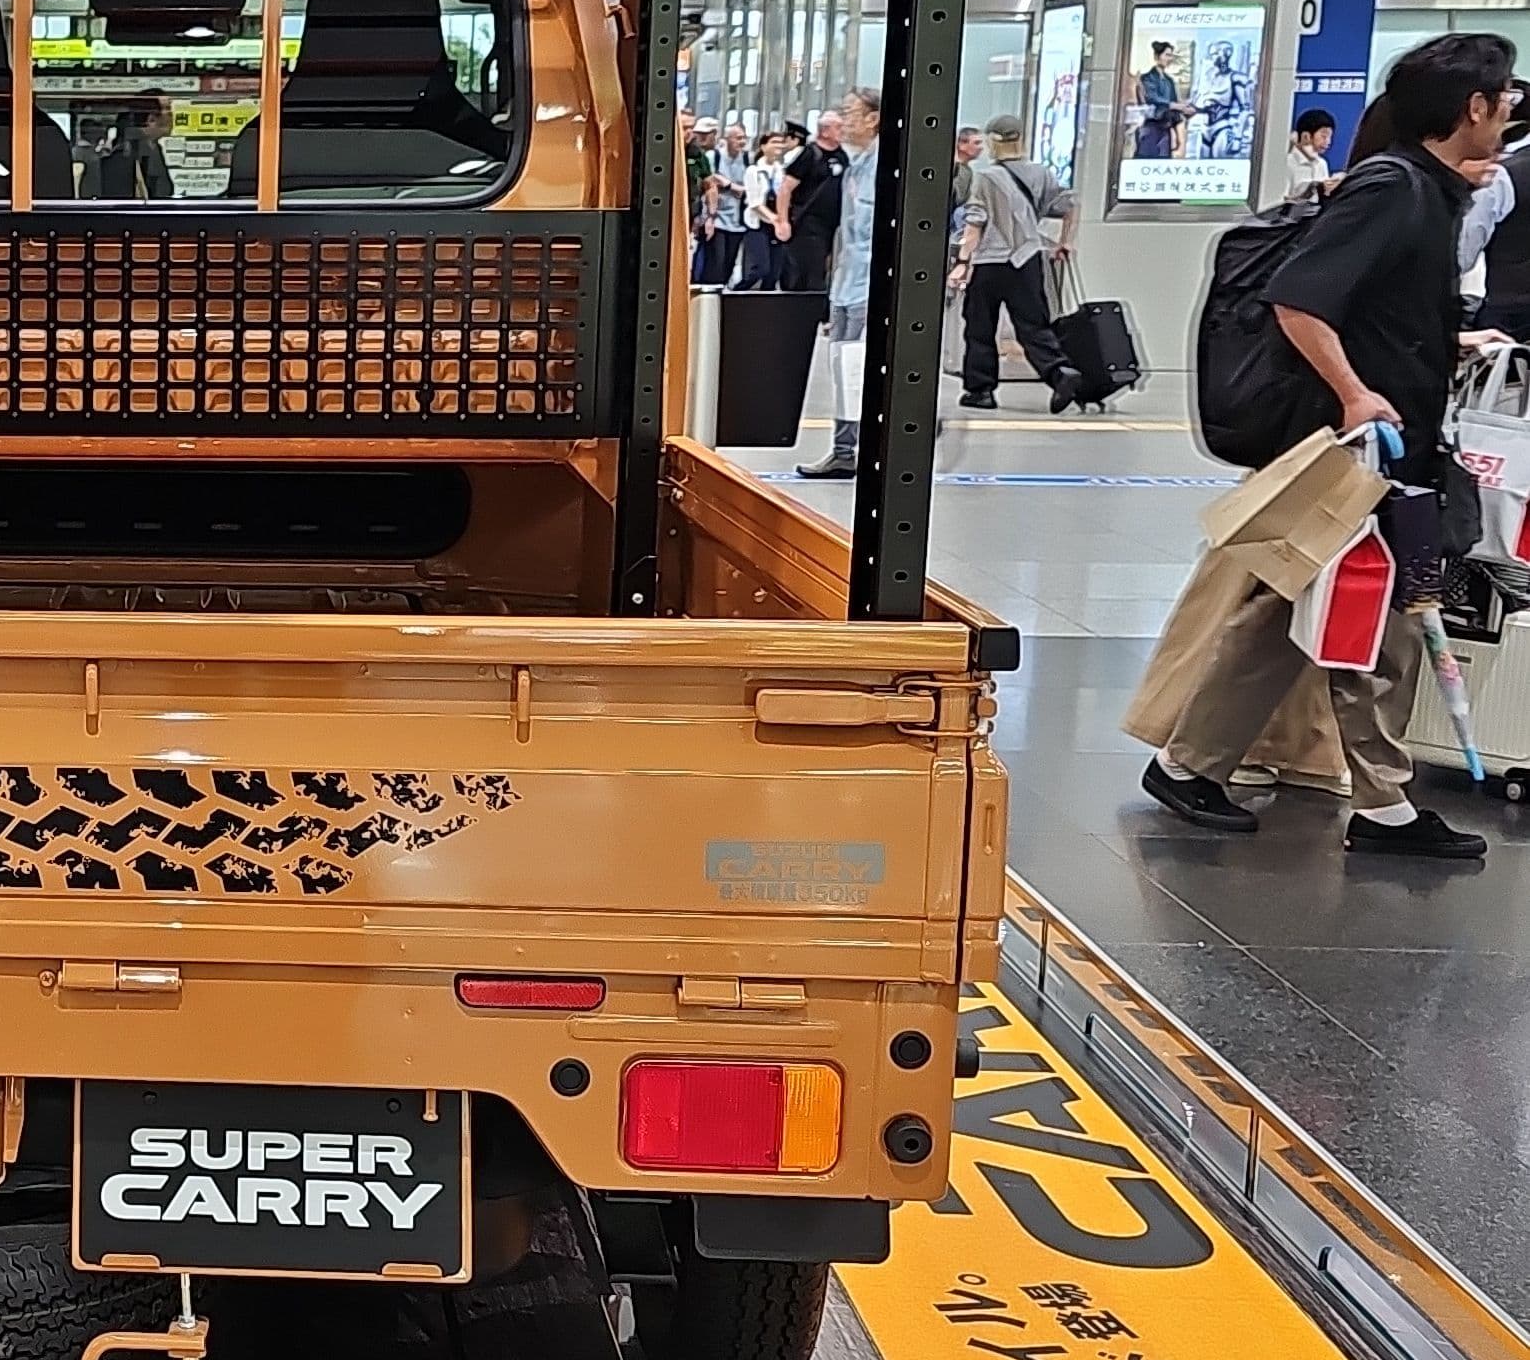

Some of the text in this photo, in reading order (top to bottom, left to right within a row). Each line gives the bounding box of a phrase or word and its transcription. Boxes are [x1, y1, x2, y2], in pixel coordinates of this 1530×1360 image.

[1148, 12, 1172, 24] OLD
[1174, 12, 1214, 24] MEETS
[1140, 166, 1230, 176] OKAYA & Co.
[1461, 451, 1505, 475] 551
[717, 858, 878, 882] CARRY
[129, 1127, 415, 1177] SUPER
[99, 1174, 444, 1230] CARRY
